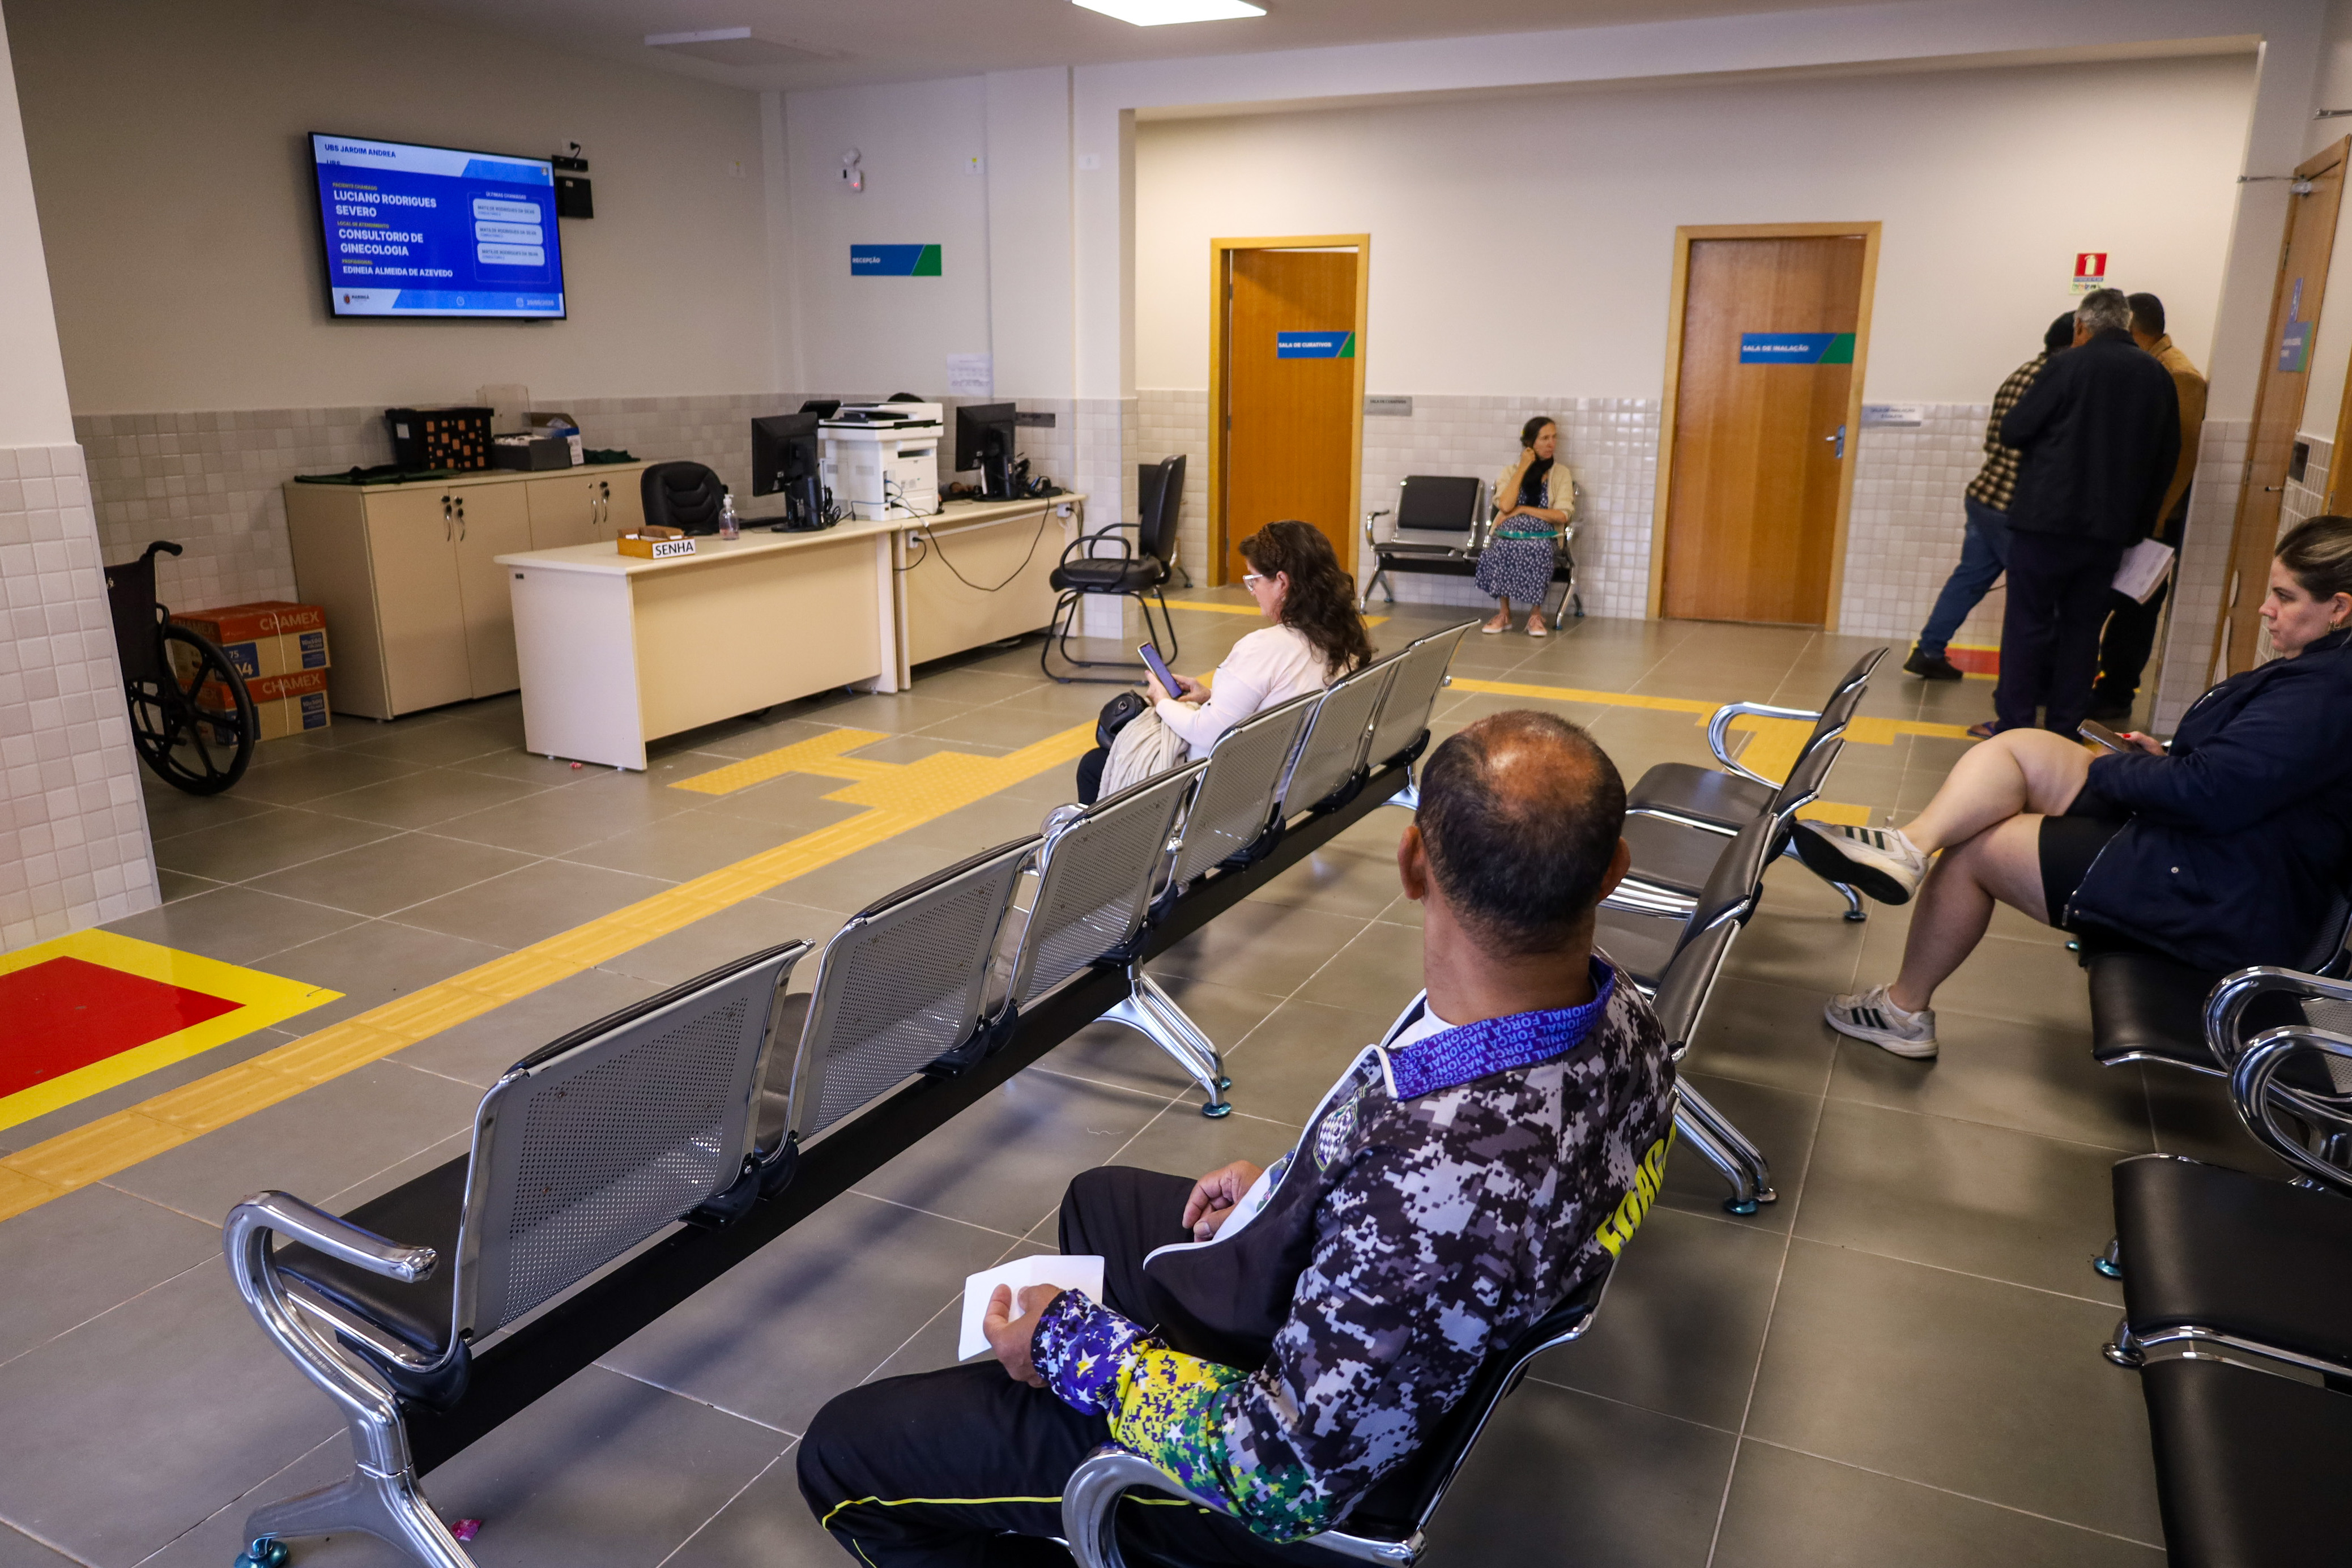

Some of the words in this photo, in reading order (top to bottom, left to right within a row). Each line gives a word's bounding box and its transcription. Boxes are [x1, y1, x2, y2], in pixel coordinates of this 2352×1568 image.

[340, 145, 367, 155] JARDIM
[368, 148, 396, 158] ANDREA
[334, 190, 380, 204] LUCIANO
[382, 194, 437, 208] RODRIGUES
[336, 204, 377, 217] SEVERO
[339, 228, 410, 243] CONSULTORIO
[411, 233, 424, 243] DE
[340, 243, 410, 256] GINECOLOGIA
[343, 266, 374, 275] EDINEIA
[374, 267, 408, 276] ALMEIDA
[409, 268, 418, 276] DE
[419, 269, 453, 277] AZEVEDO
[1773, 344, 1809, 352] INALAÇÃO
[655, 541, 694, 556] SENHA
[259, 611, 320, 631] CHAMEX
[229, 650, 240, 659] 75
[262, 673, 321, 694] CHAMEX
[1428, 1020, 1492, 1058] NACIONAL
[1424, 1029, 1489, 1071] NACIONAL
